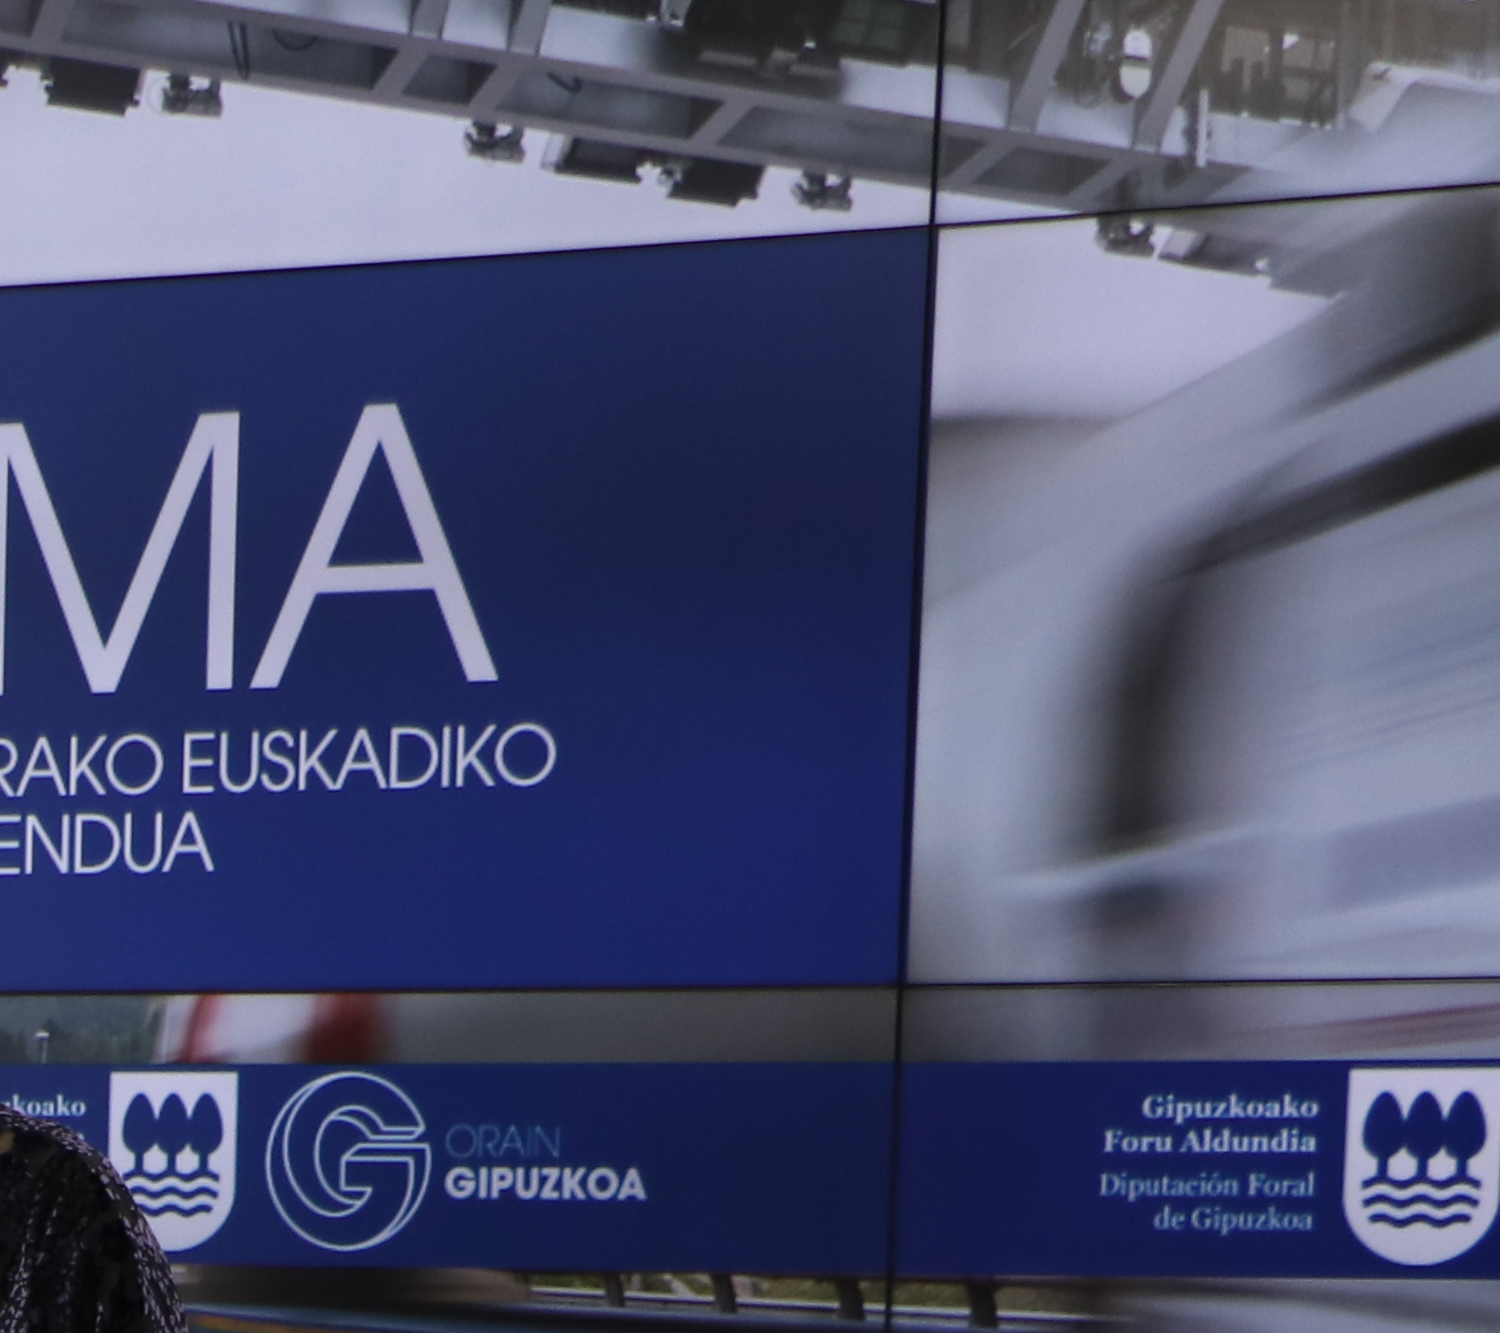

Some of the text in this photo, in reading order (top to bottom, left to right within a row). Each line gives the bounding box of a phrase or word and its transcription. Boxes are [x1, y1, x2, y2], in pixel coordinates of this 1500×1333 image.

[182, 722, 557, 794] EUSKADIKO
[1141, 1093, 1320, 1127] Gipuzkoako
[445, 1124, 560, 1159] ORAIN
[1103, 1128, 1317, 1153] Foru Aldundia
[444, 1166, 647, 1201] GIPUZKOA
[1099, 1172, 1315, 1203] Diputación Foral
[1153, 1205, 1314, 1235] de Gipuzkoa
